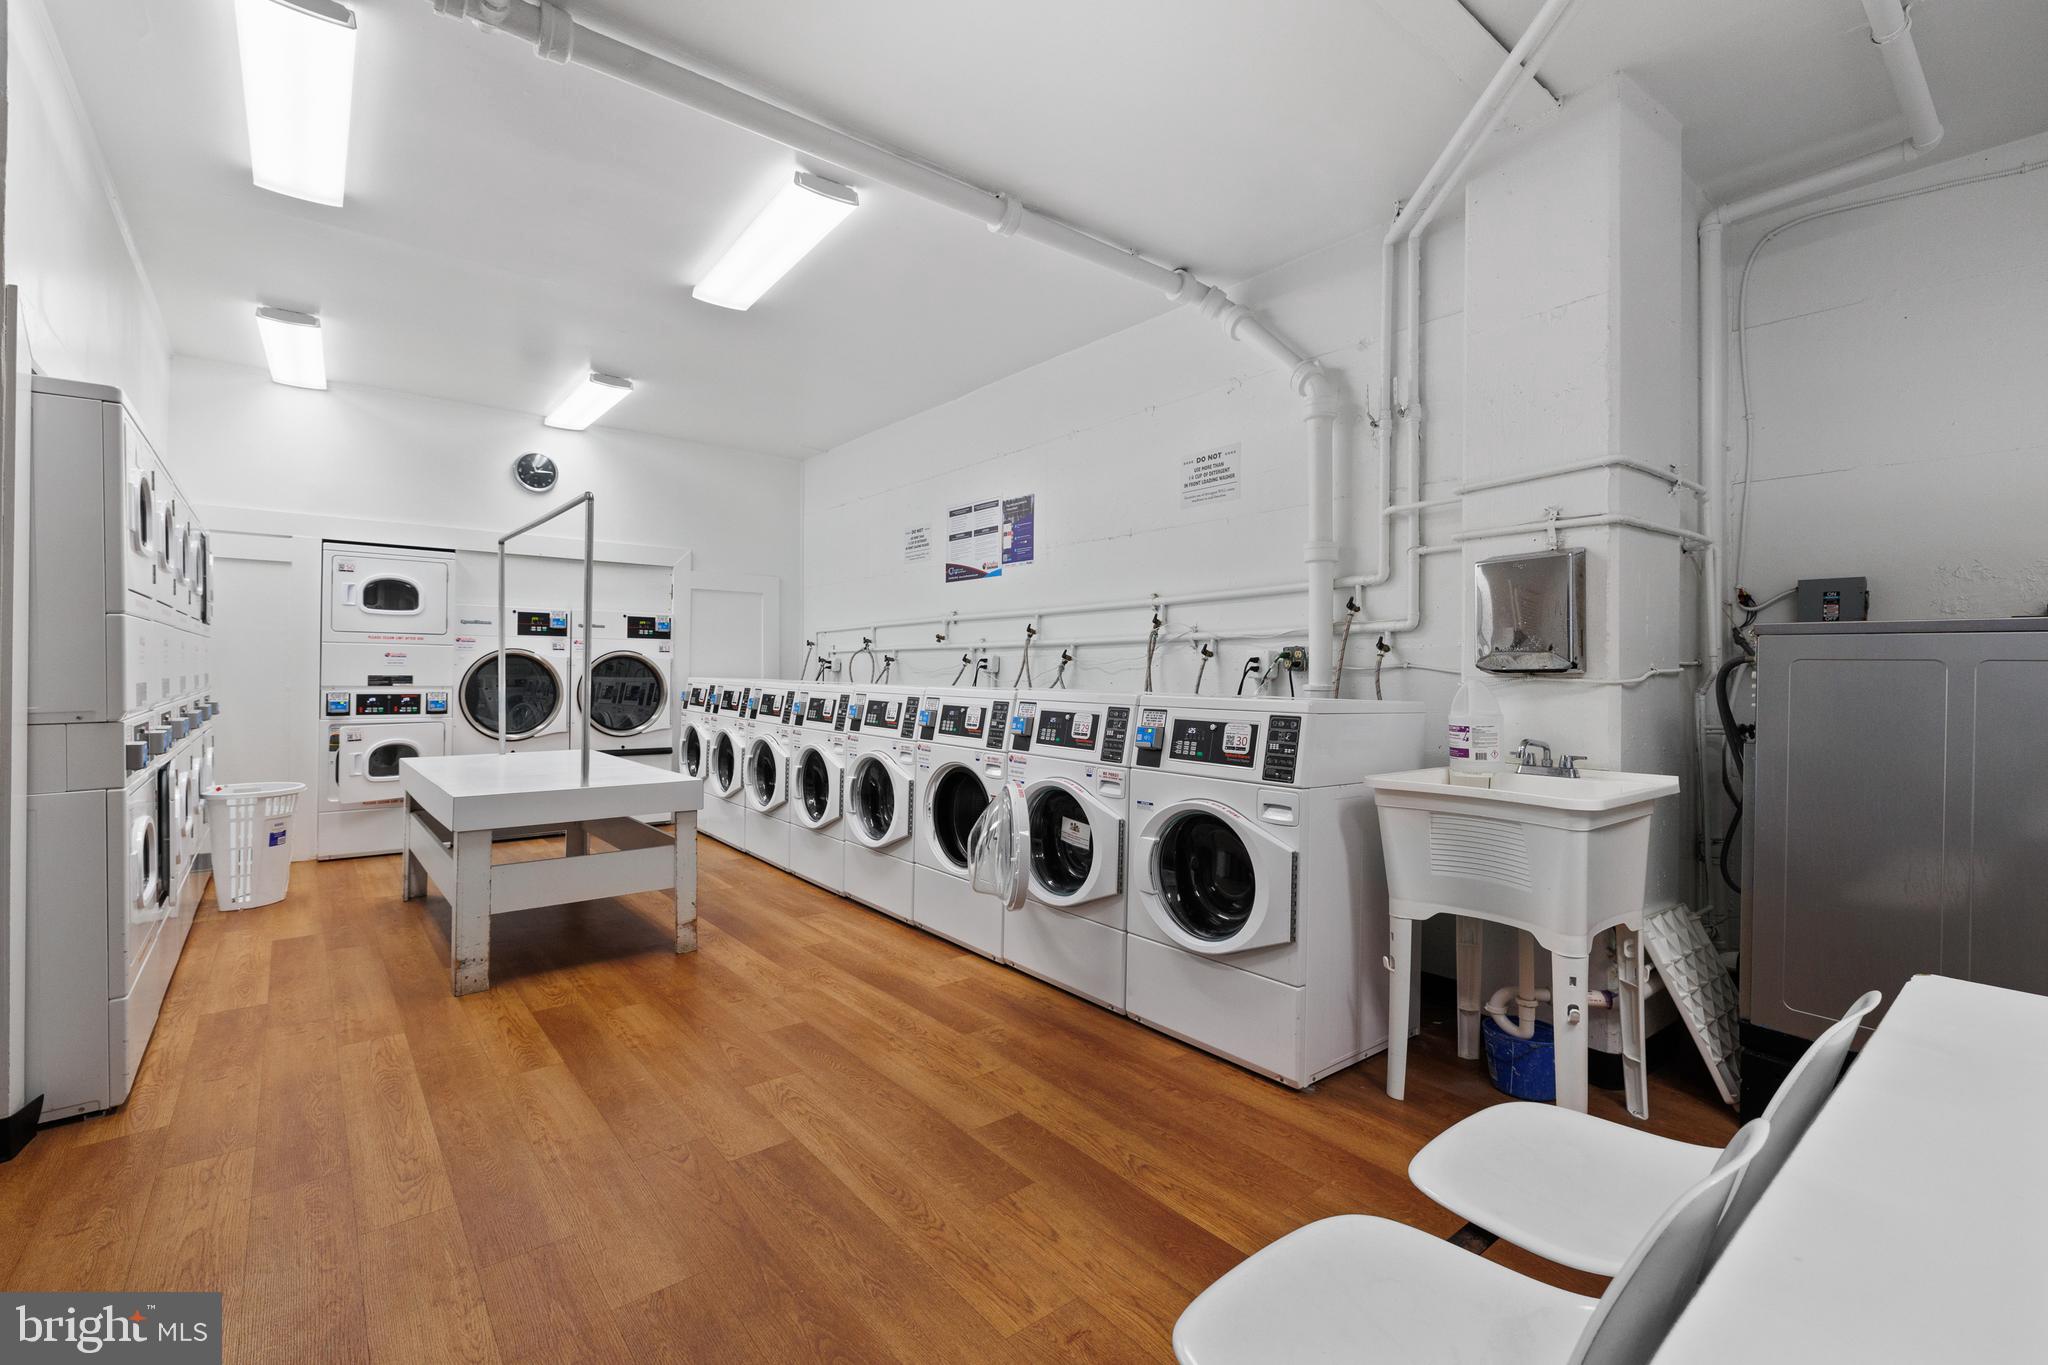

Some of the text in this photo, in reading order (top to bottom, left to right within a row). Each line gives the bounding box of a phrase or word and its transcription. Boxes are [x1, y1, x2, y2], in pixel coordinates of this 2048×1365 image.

[1196, 452, 1222, 464] DO NOT
[1209, 467, 1230, 476] DETERGENT
[1202, 476, 1218, 484] LOADING
[1080, 723, 1089, 733] 29
[1236, 736, 1248, 746] 30
